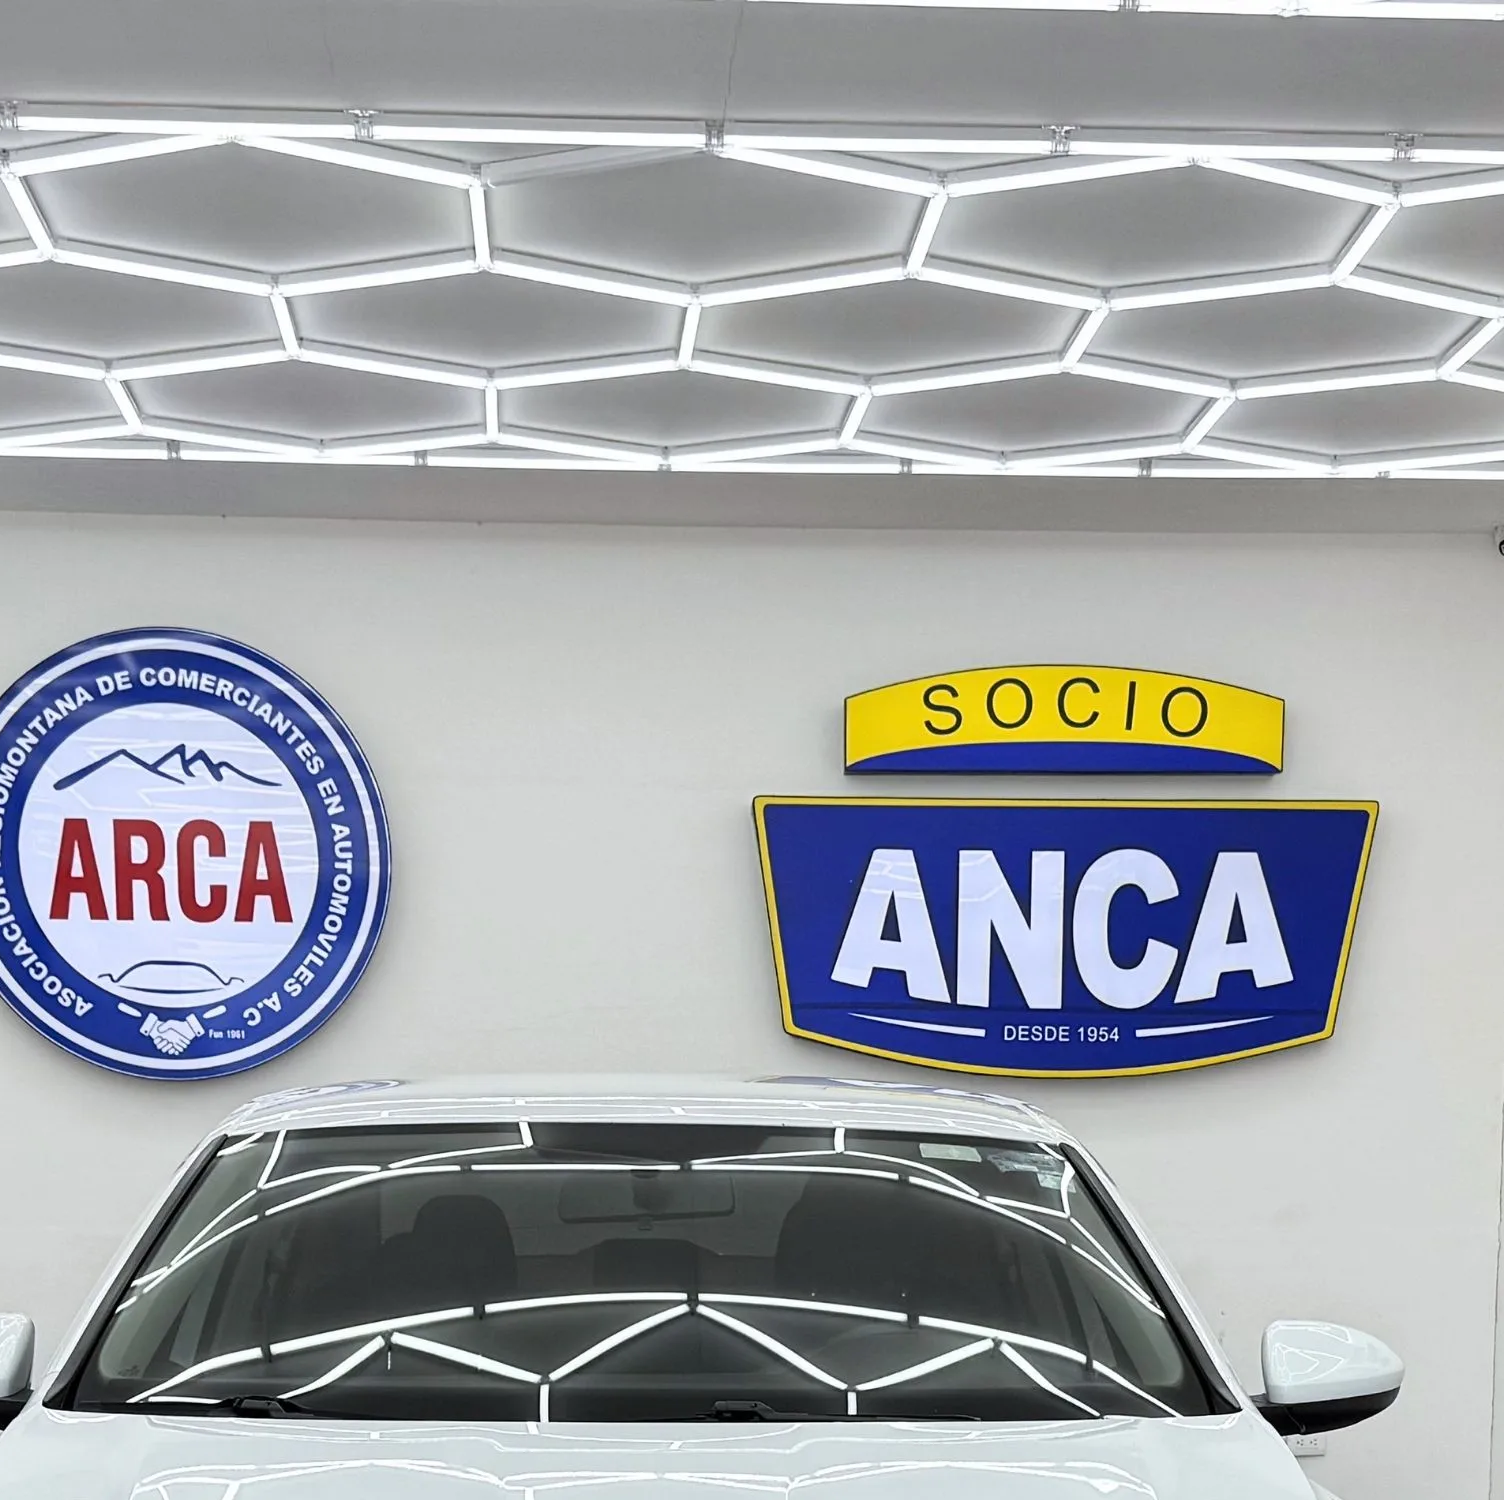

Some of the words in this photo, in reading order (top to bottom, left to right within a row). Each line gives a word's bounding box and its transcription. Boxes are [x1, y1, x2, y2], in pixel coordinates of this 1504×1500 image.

[96, 670, 132, 696] DE
[140, 667, 325, 775] COMERCIANTES
[923, 677, 1208, 737] SOCIO
[317, 778, 345, 816] EN
[49, 818, 293, 923] ARCA
[284, 824, 353, 997] AUTOMOVILES
[830, 848, 1294, 1009] ANCA
[1003, 1025, 1070, 1042] DESDE
[1077, 1026, 1119, 1042] 1954
